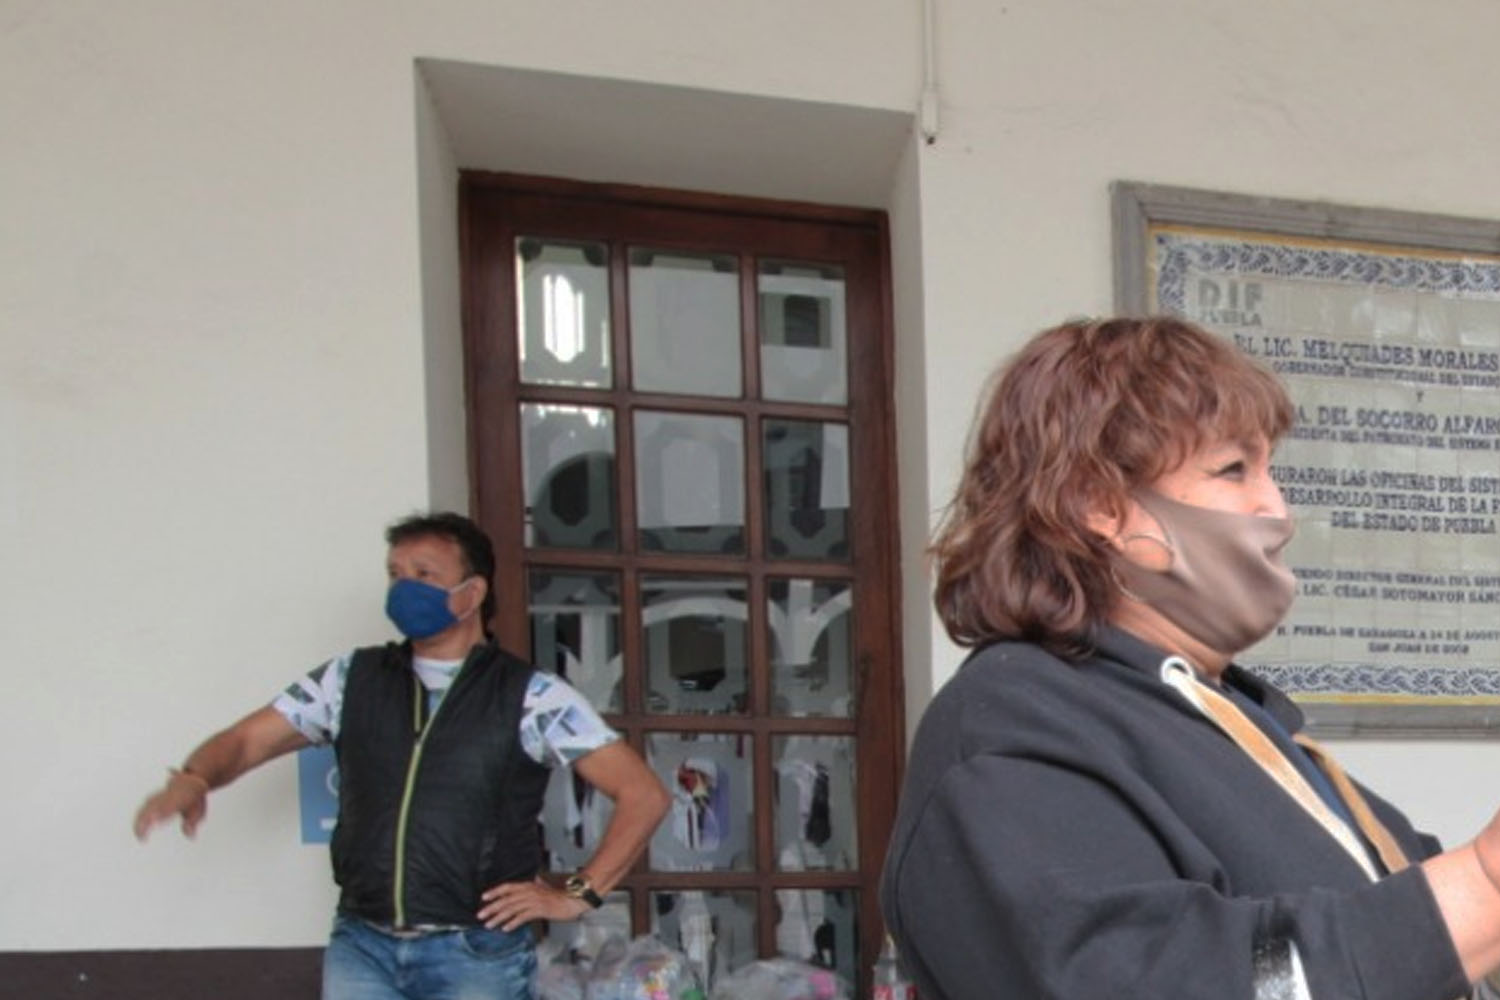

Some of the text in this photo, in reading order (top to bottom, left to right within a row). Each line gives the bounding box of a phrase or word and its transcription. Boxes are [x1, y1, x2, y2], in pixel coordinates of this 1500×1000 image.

[1264, 338, 1298, 357] LIC.
[1303, 341, 1415, 366] MELQUIADES
[1420, 349, 1499, 372] MORALES
[1319, 408, 1351, 426] DEL
[1357, 410, 1439, 433] SOCORRO
[1342, 471, 1367, 488] LAS
[1371, 472, 1435, 492] OFICINAS
[1439, 478, 1465, 493] DEL
[1376, 495, 1445, 512] INTEGRAL
[1449, 498, 1468, 513] DE
[1472, 499, 1489, 514] LA
[1332, 512, 1497, 535] DEL ESTADO DE PUEBLA
